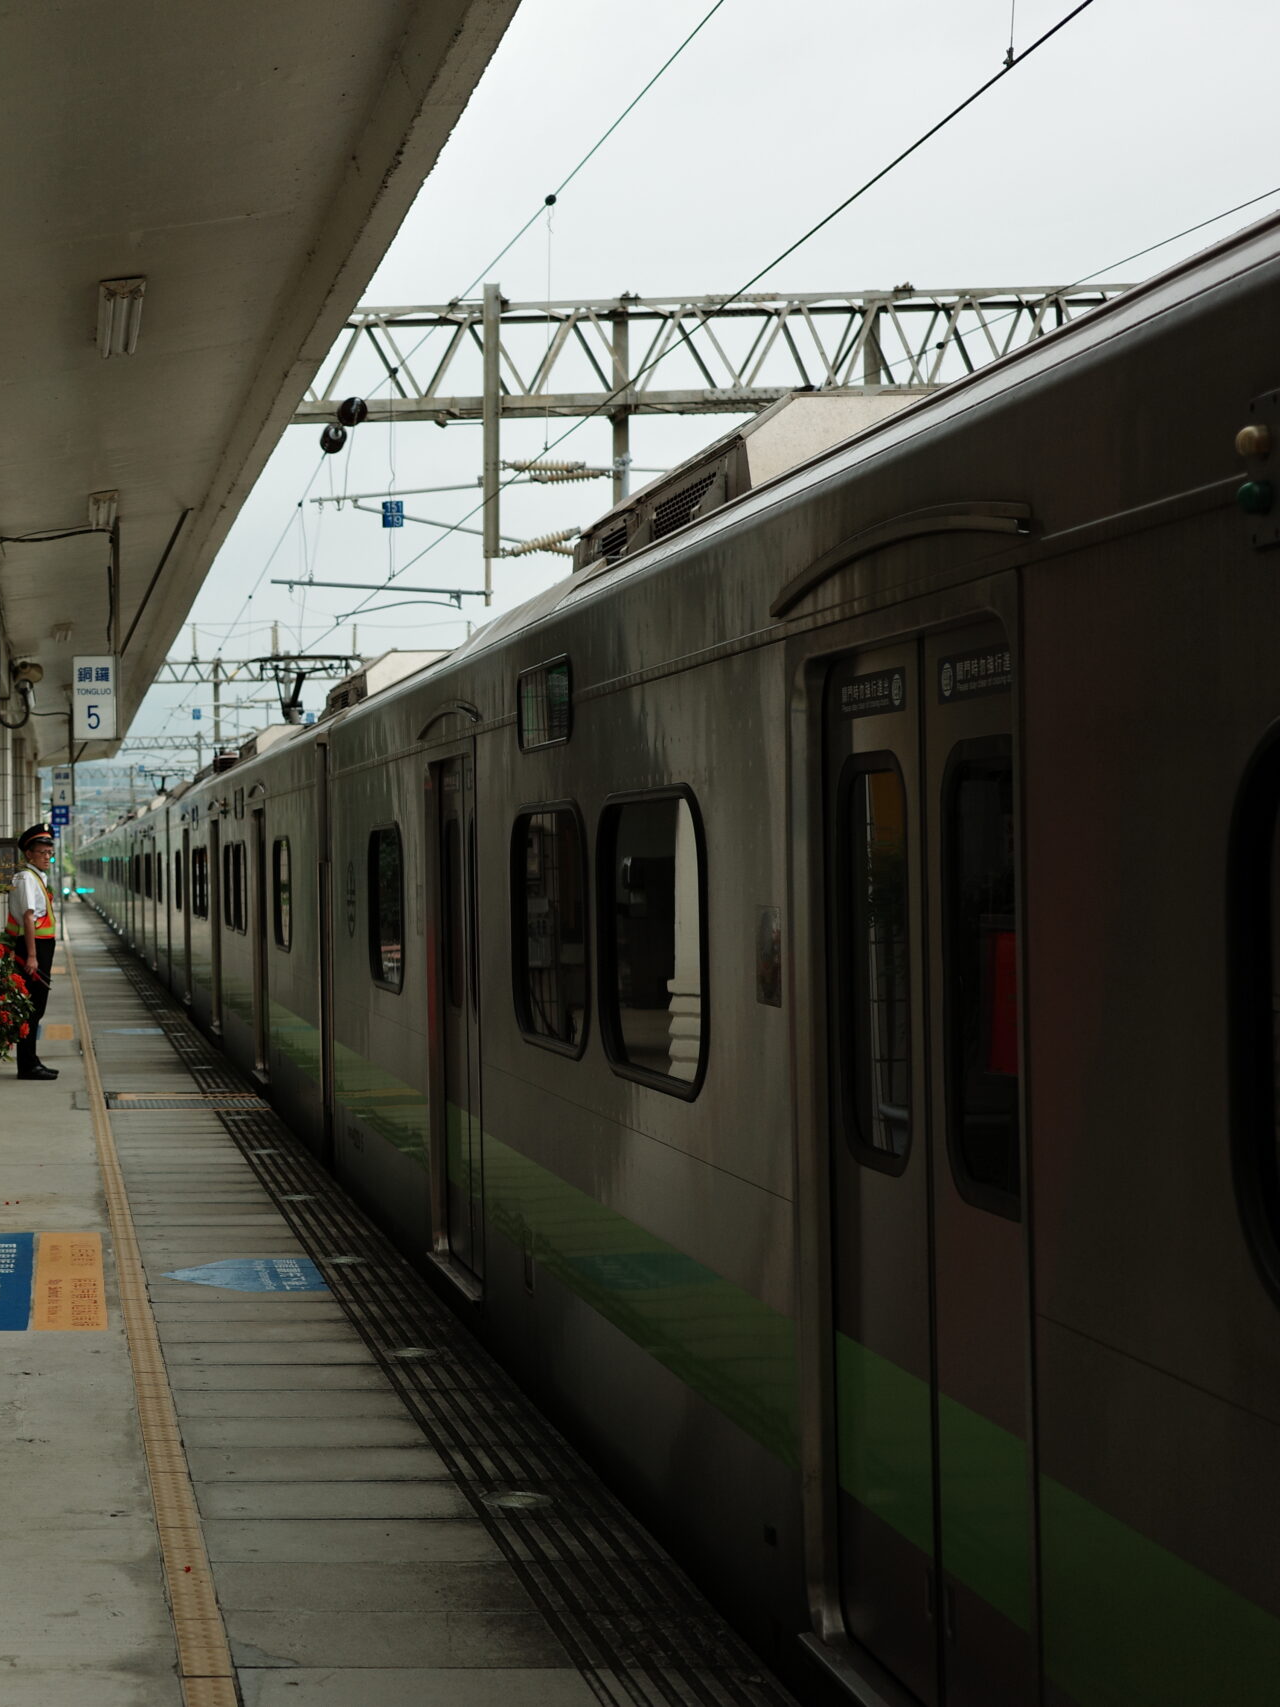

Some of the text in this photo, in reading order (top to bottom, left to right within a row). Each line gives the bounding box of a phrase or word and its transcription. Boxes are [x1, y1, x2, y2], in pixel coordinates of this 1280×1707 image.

[77, 667, 110, 683] 銅鑼
[76, 688, 112, 696] TONGLUO
[87, 705, 101, 730] 5
[59, 790, 66, 801] 4
